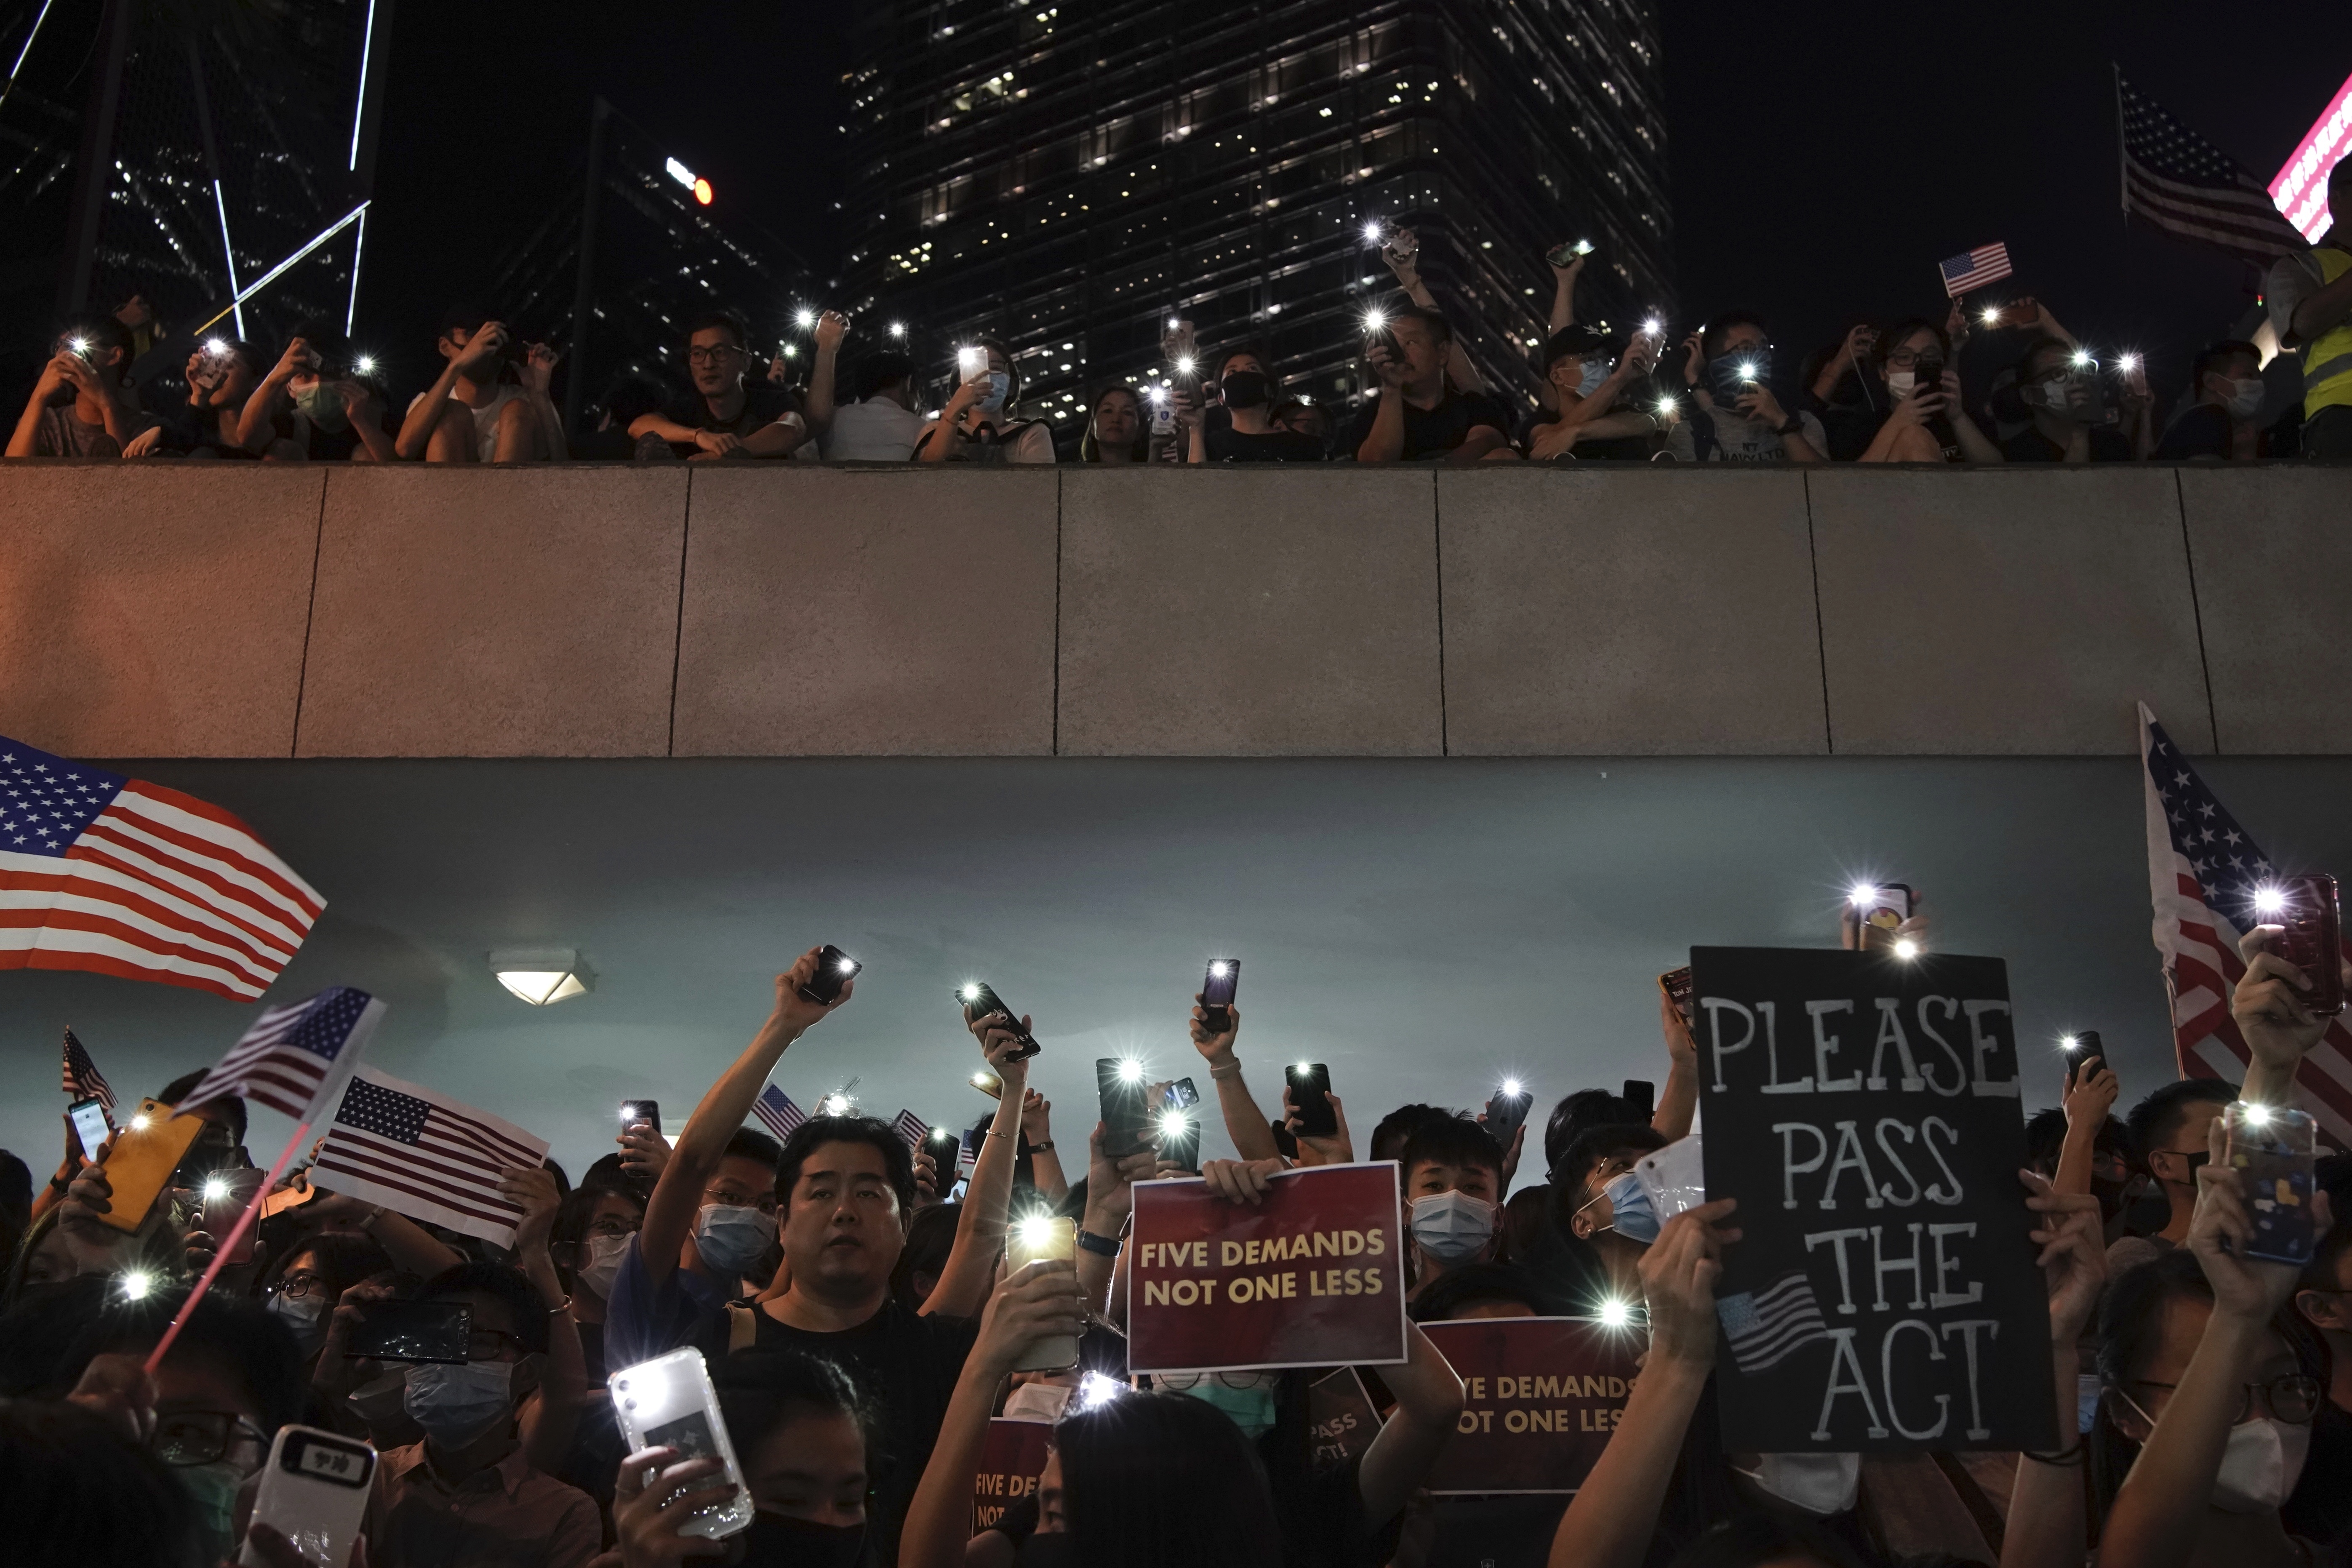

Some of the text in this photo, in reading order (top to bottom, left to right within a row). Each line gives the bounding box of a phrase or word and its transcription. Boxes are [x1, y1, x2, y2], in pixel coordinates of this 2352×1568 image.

[1672, 989, 1685, 997] TOM
[1700, 995, 2020, 1098] PLEASE
[1772, 1117, 1964, 1210] PASS
[1141, 1228, 1385, 1268] FIVE DEMANDS
[1144, 1268, 1383, 1306] NOT ONE LESS
[1805, 1222, 1984, 1314] THE
[1811, 1319, 1999, 1441] ACT
[1457, 1410, 1494, 1434] OT
[1504, 1409, 1569, 1433] ONE
[976, 1473, 1004, 1495] FIVE
[978, 1506, 1005, 1527] NOT
